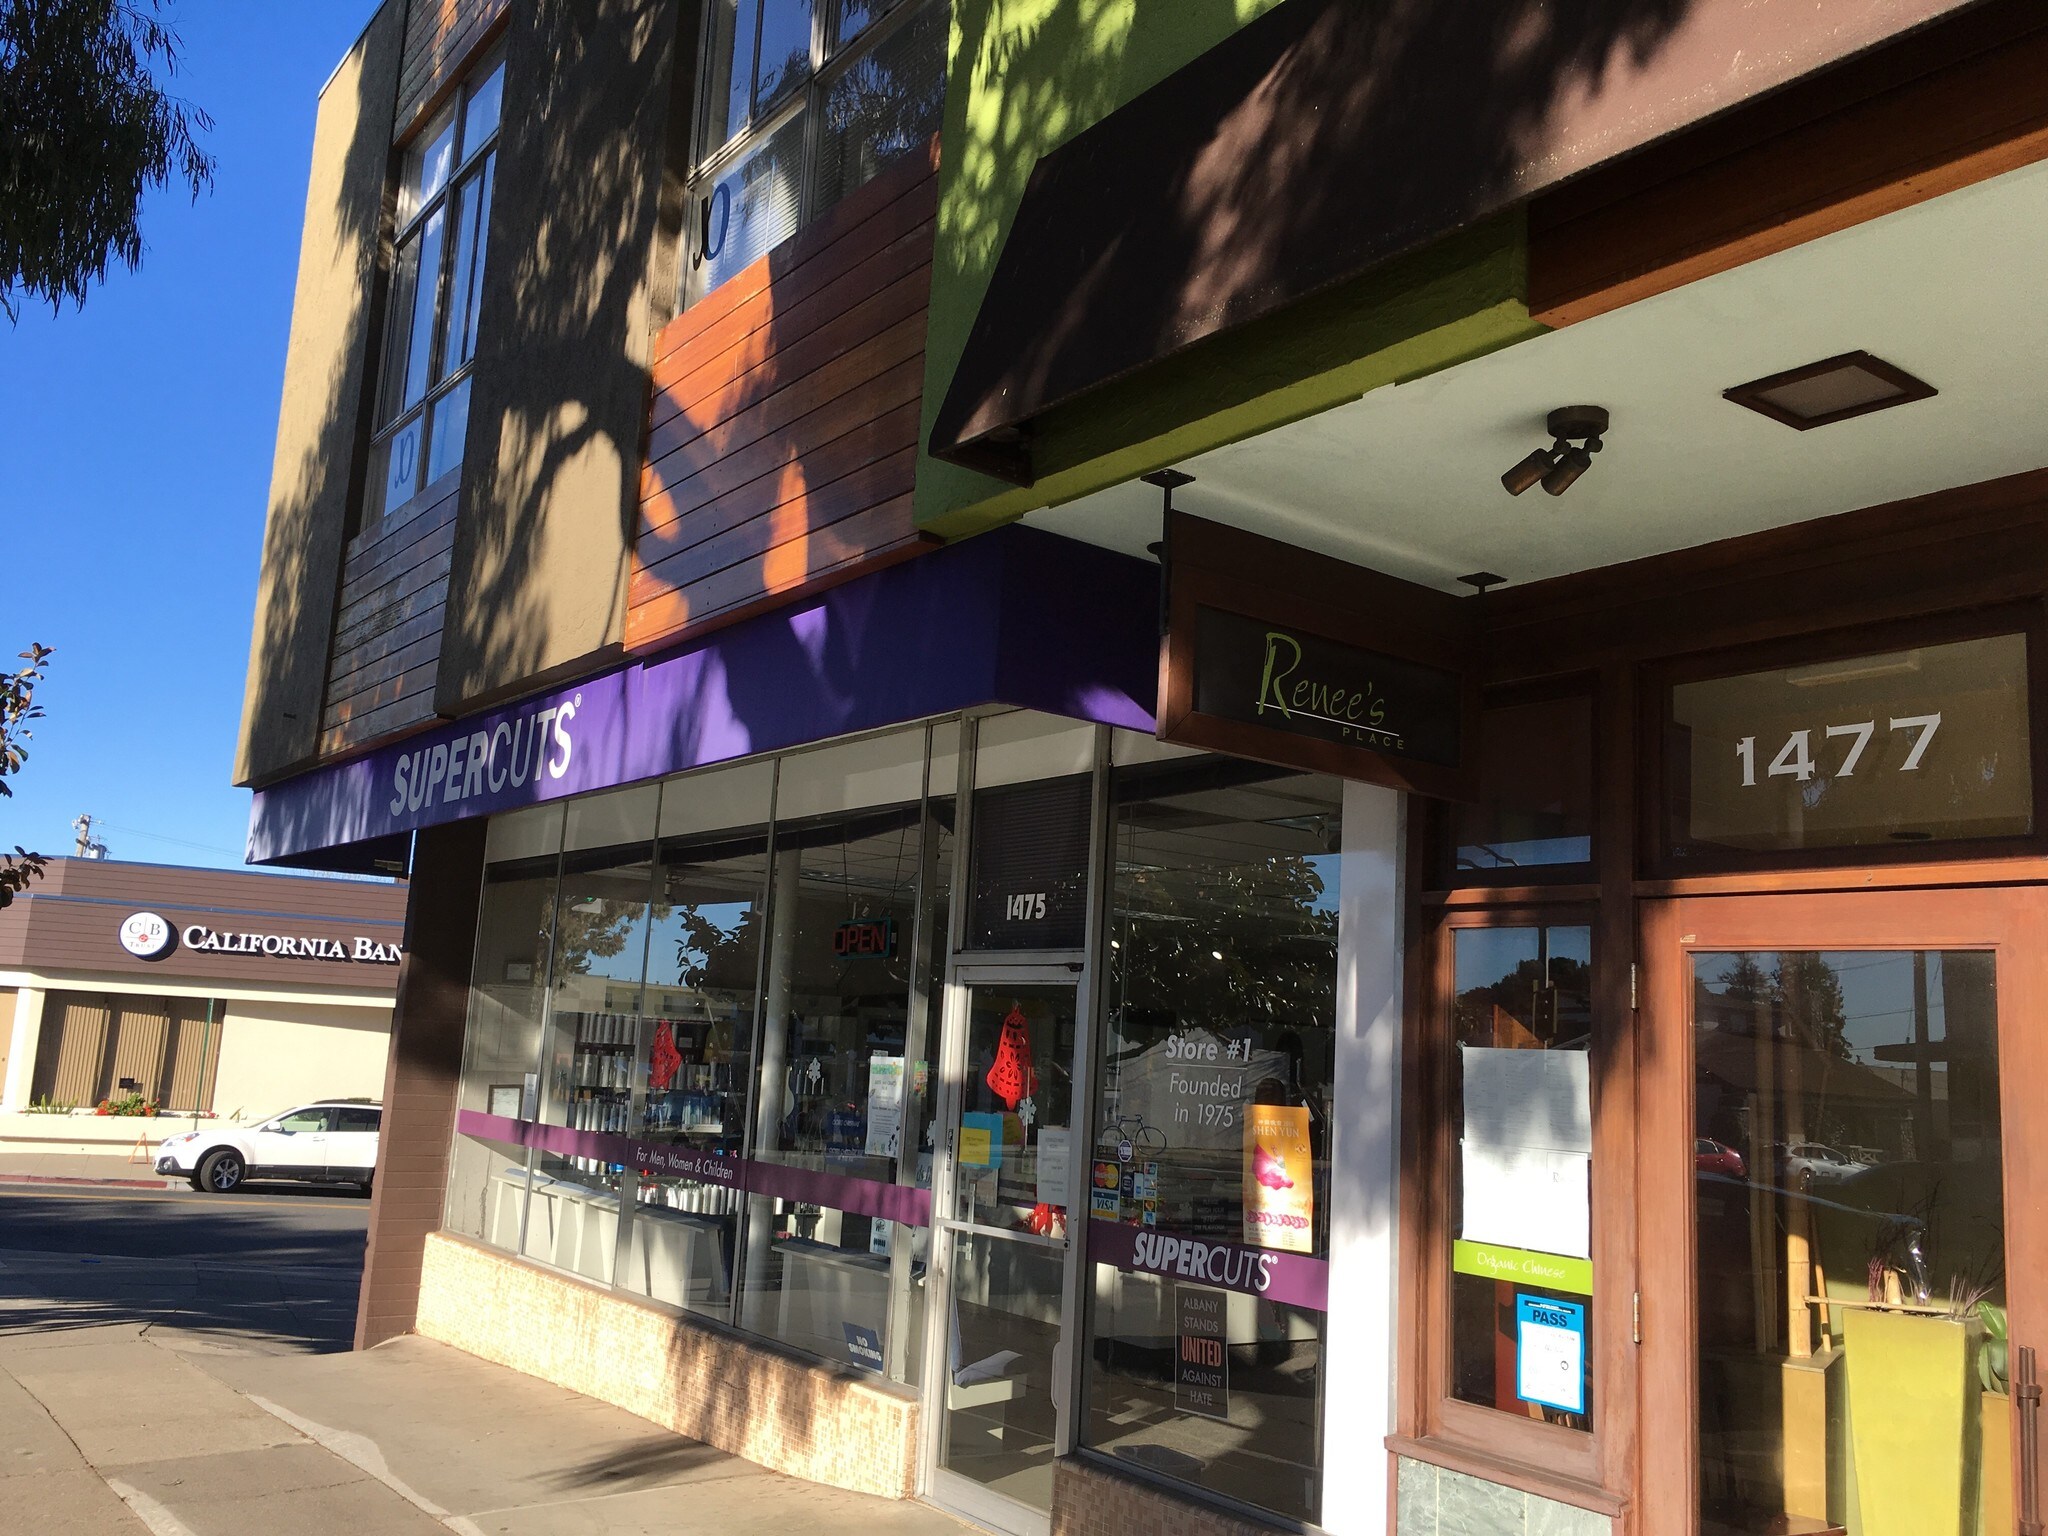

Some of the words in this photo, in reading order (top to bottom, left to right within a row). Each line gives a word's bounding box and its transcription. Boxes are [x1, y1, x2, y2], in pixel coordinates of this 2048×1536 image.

[1342, 726, 1404, 750] PLACE
[1736, 711, 1941, 787] 1477
[1006, 892, 1046, 921] 1475
[182, 925, 346, 959] CALIFORNIA
[832, 921, 887, 954] OPEN
[1165, 1034, 1218, 1061] Store
[1226, 1038, 1252, 1062] #1
[1169, 1072, 1242, 1099] Founded
[1174, 1102, 1189, 1123] in
[1198, 1103, 1234, 1128] 1975
[1252, 1125, 1277, 1137] SHEN
[1280, 1126, 1300, 1138] YUN
[636, 1147, 648, 1162] For
[649, 1150, 666, 1168] Men,
[668, 1152, 693, 1173] Women
[694, 1157, 702, 1173] &
[703, 1159, 734, 1181] Children
[1096, 1199, 1114, 1211] VISA
[1477, 1251, 1518, 1275] Organic
[1522, 1259, 1566, 1279] Chinese
[1183, 1296, 1219, 1314] ALBANY
[1183, 1315, 1219, 1333] STANDS
[1532, 1309, 1568, 1328] PASS
[848, 1342, 882, 1362] SMOKING
[855, 1335, 868, 1348] NO
[1181, 1335, 1222, 1367] UNITED
[1181, 1368, 1222, 1388] AGAINST
[1189, 1390, 1213, 1407] HATE
